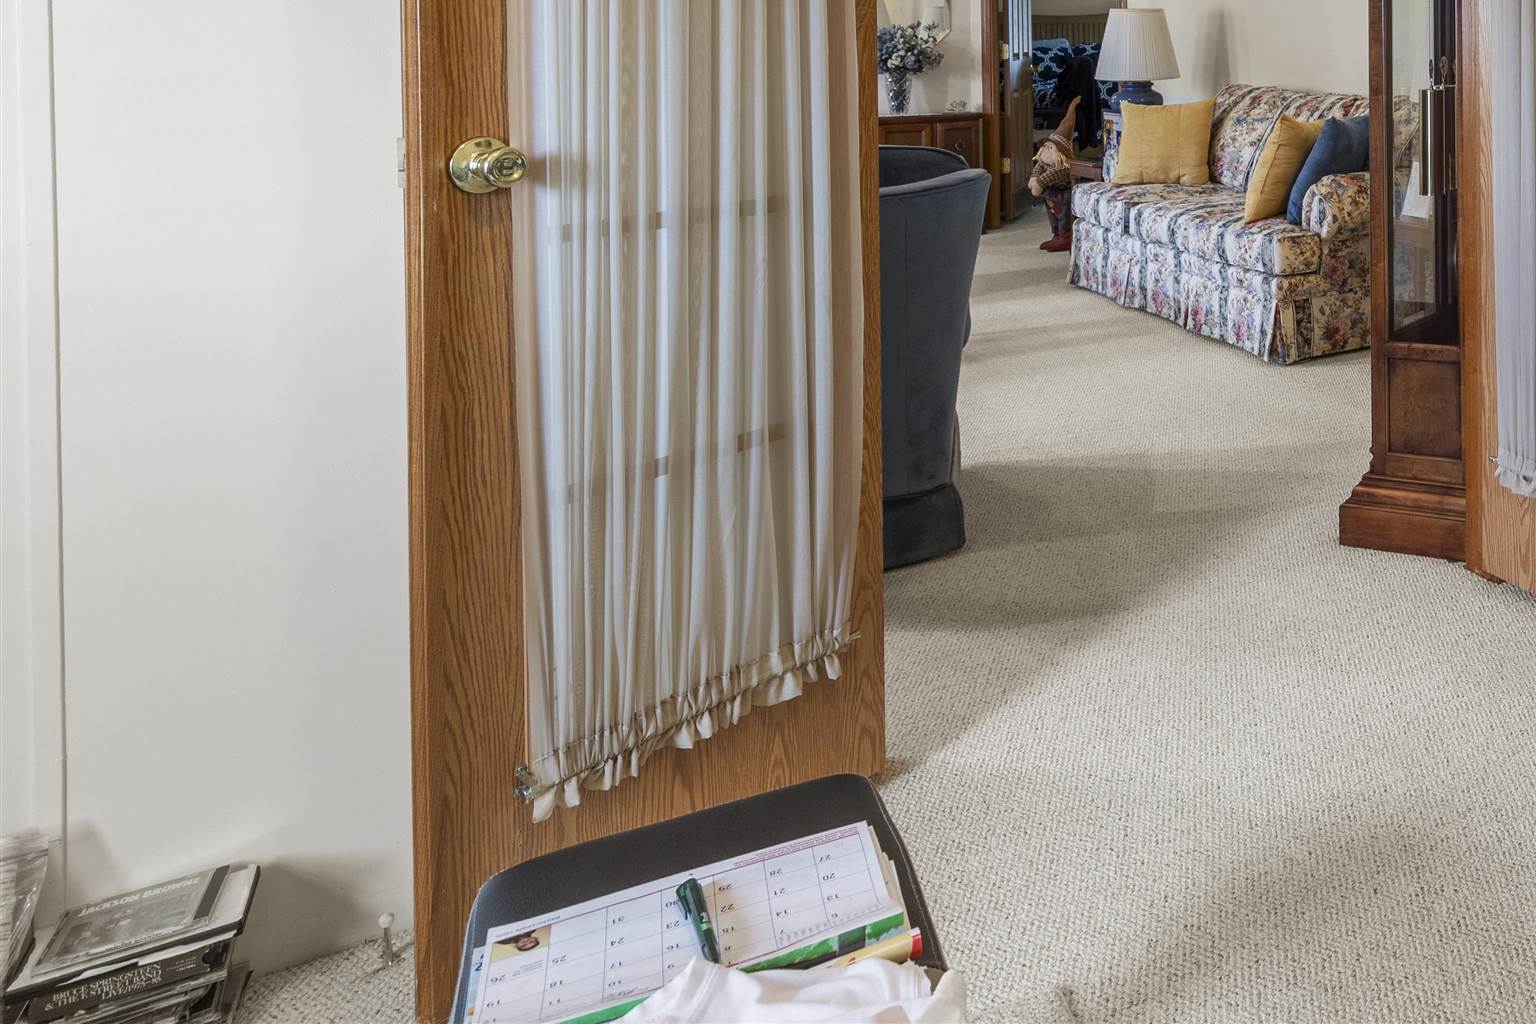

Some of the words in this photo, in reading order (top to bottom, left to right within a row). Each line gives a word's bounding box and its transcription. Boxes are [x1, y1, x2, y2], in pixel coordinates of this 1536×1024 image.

[822, 872, 837, 881] 20
[718, 883, 733, 892] 29
[78, 894, 140, 918] JACKSON
[142, 876, 200, 899] BROWNE
[720, 903, 735, 913] 22
[612, 916, 625, 925] 31
[666, 919, 680, 930] 23
[611, 936, 625, 947] 24
[667, 943, 680, 951] 16
[552, 954, 567, 964] 25
[610, 960, 623, 969] 17
[51, 981, 87, 1001] BRUCE
[89, 963, 162, 991] SPRINGSTEEN
[490, 974, 506, 984] 26
[550, 979, 563, 988] 18
[608, 979, 622, 988] 10
[55, 994, 81, 1008] THE
[91, 977, 131, 997] STREET
[136, 968, 162, 983] BAND
